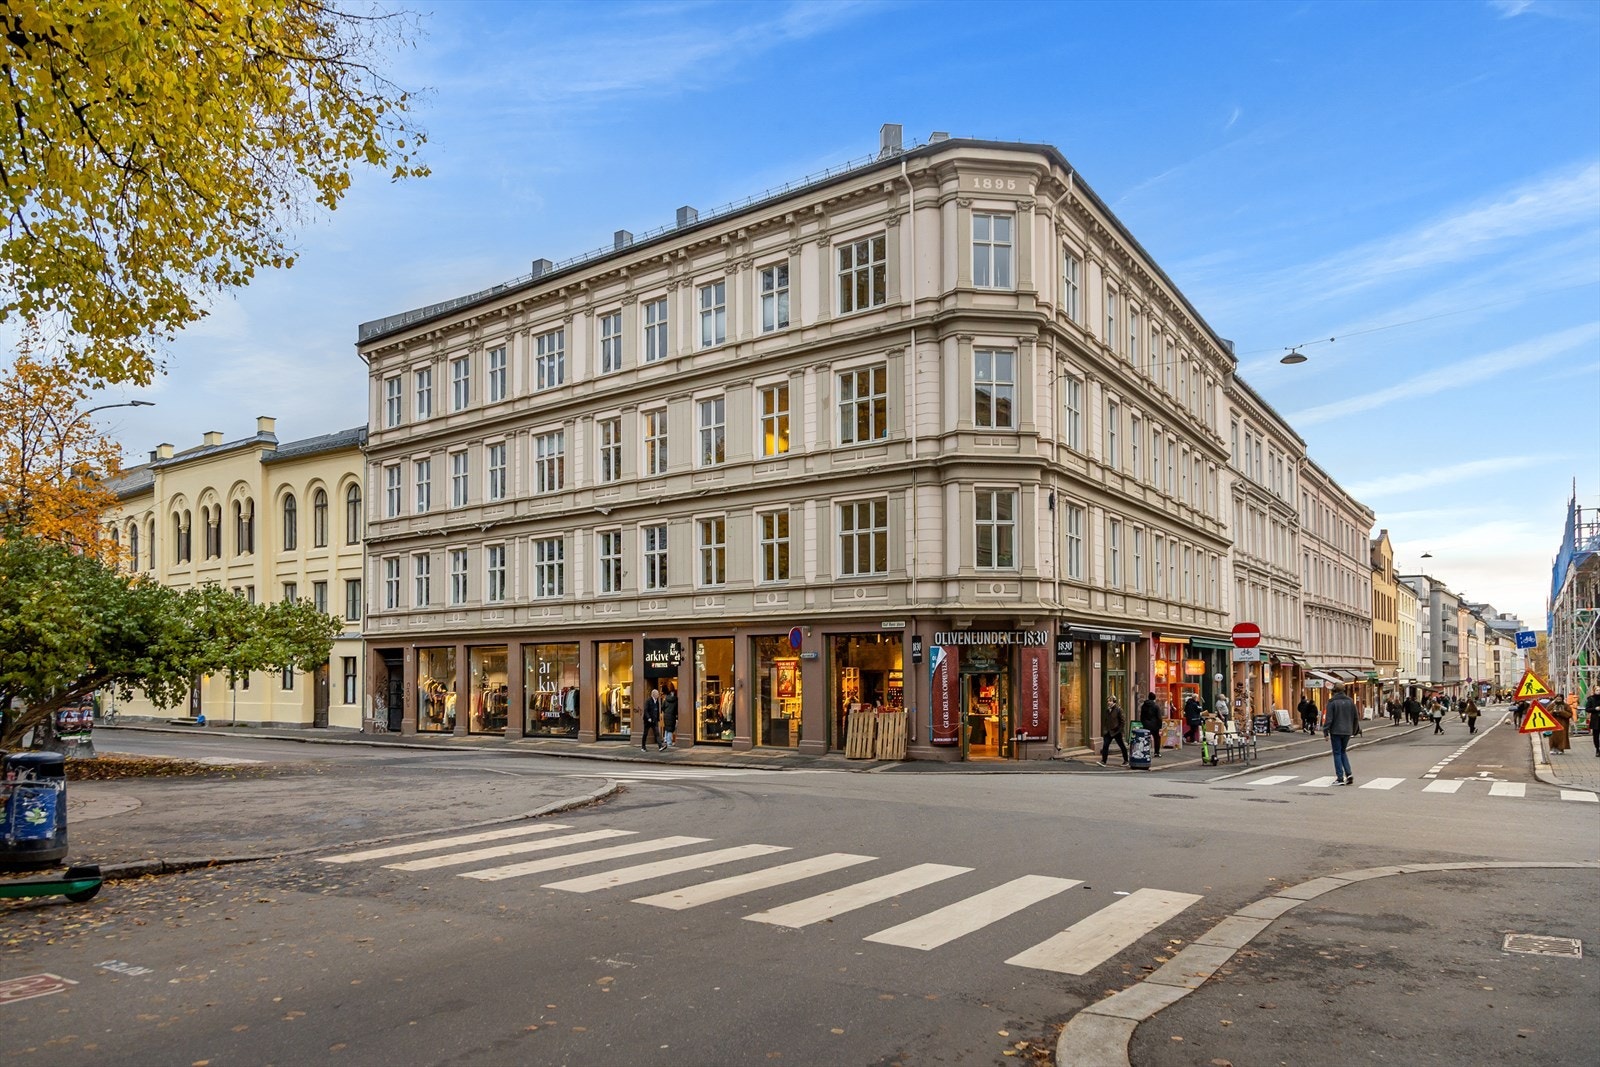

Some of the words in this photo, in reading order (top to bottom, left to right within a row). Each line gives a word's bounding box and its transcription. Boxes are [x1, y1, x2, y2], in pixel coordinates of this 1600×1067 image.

[973, 177, 1016, 190] 1895
[935, 632, 1010, 645] OLIVENLUNDEN
[1023, 631, 1048, 646] 1830
[645, 650, 668, 661] arkive
[539, 661, 551, 674] ar
[539, 676, 558, 692] kiv
